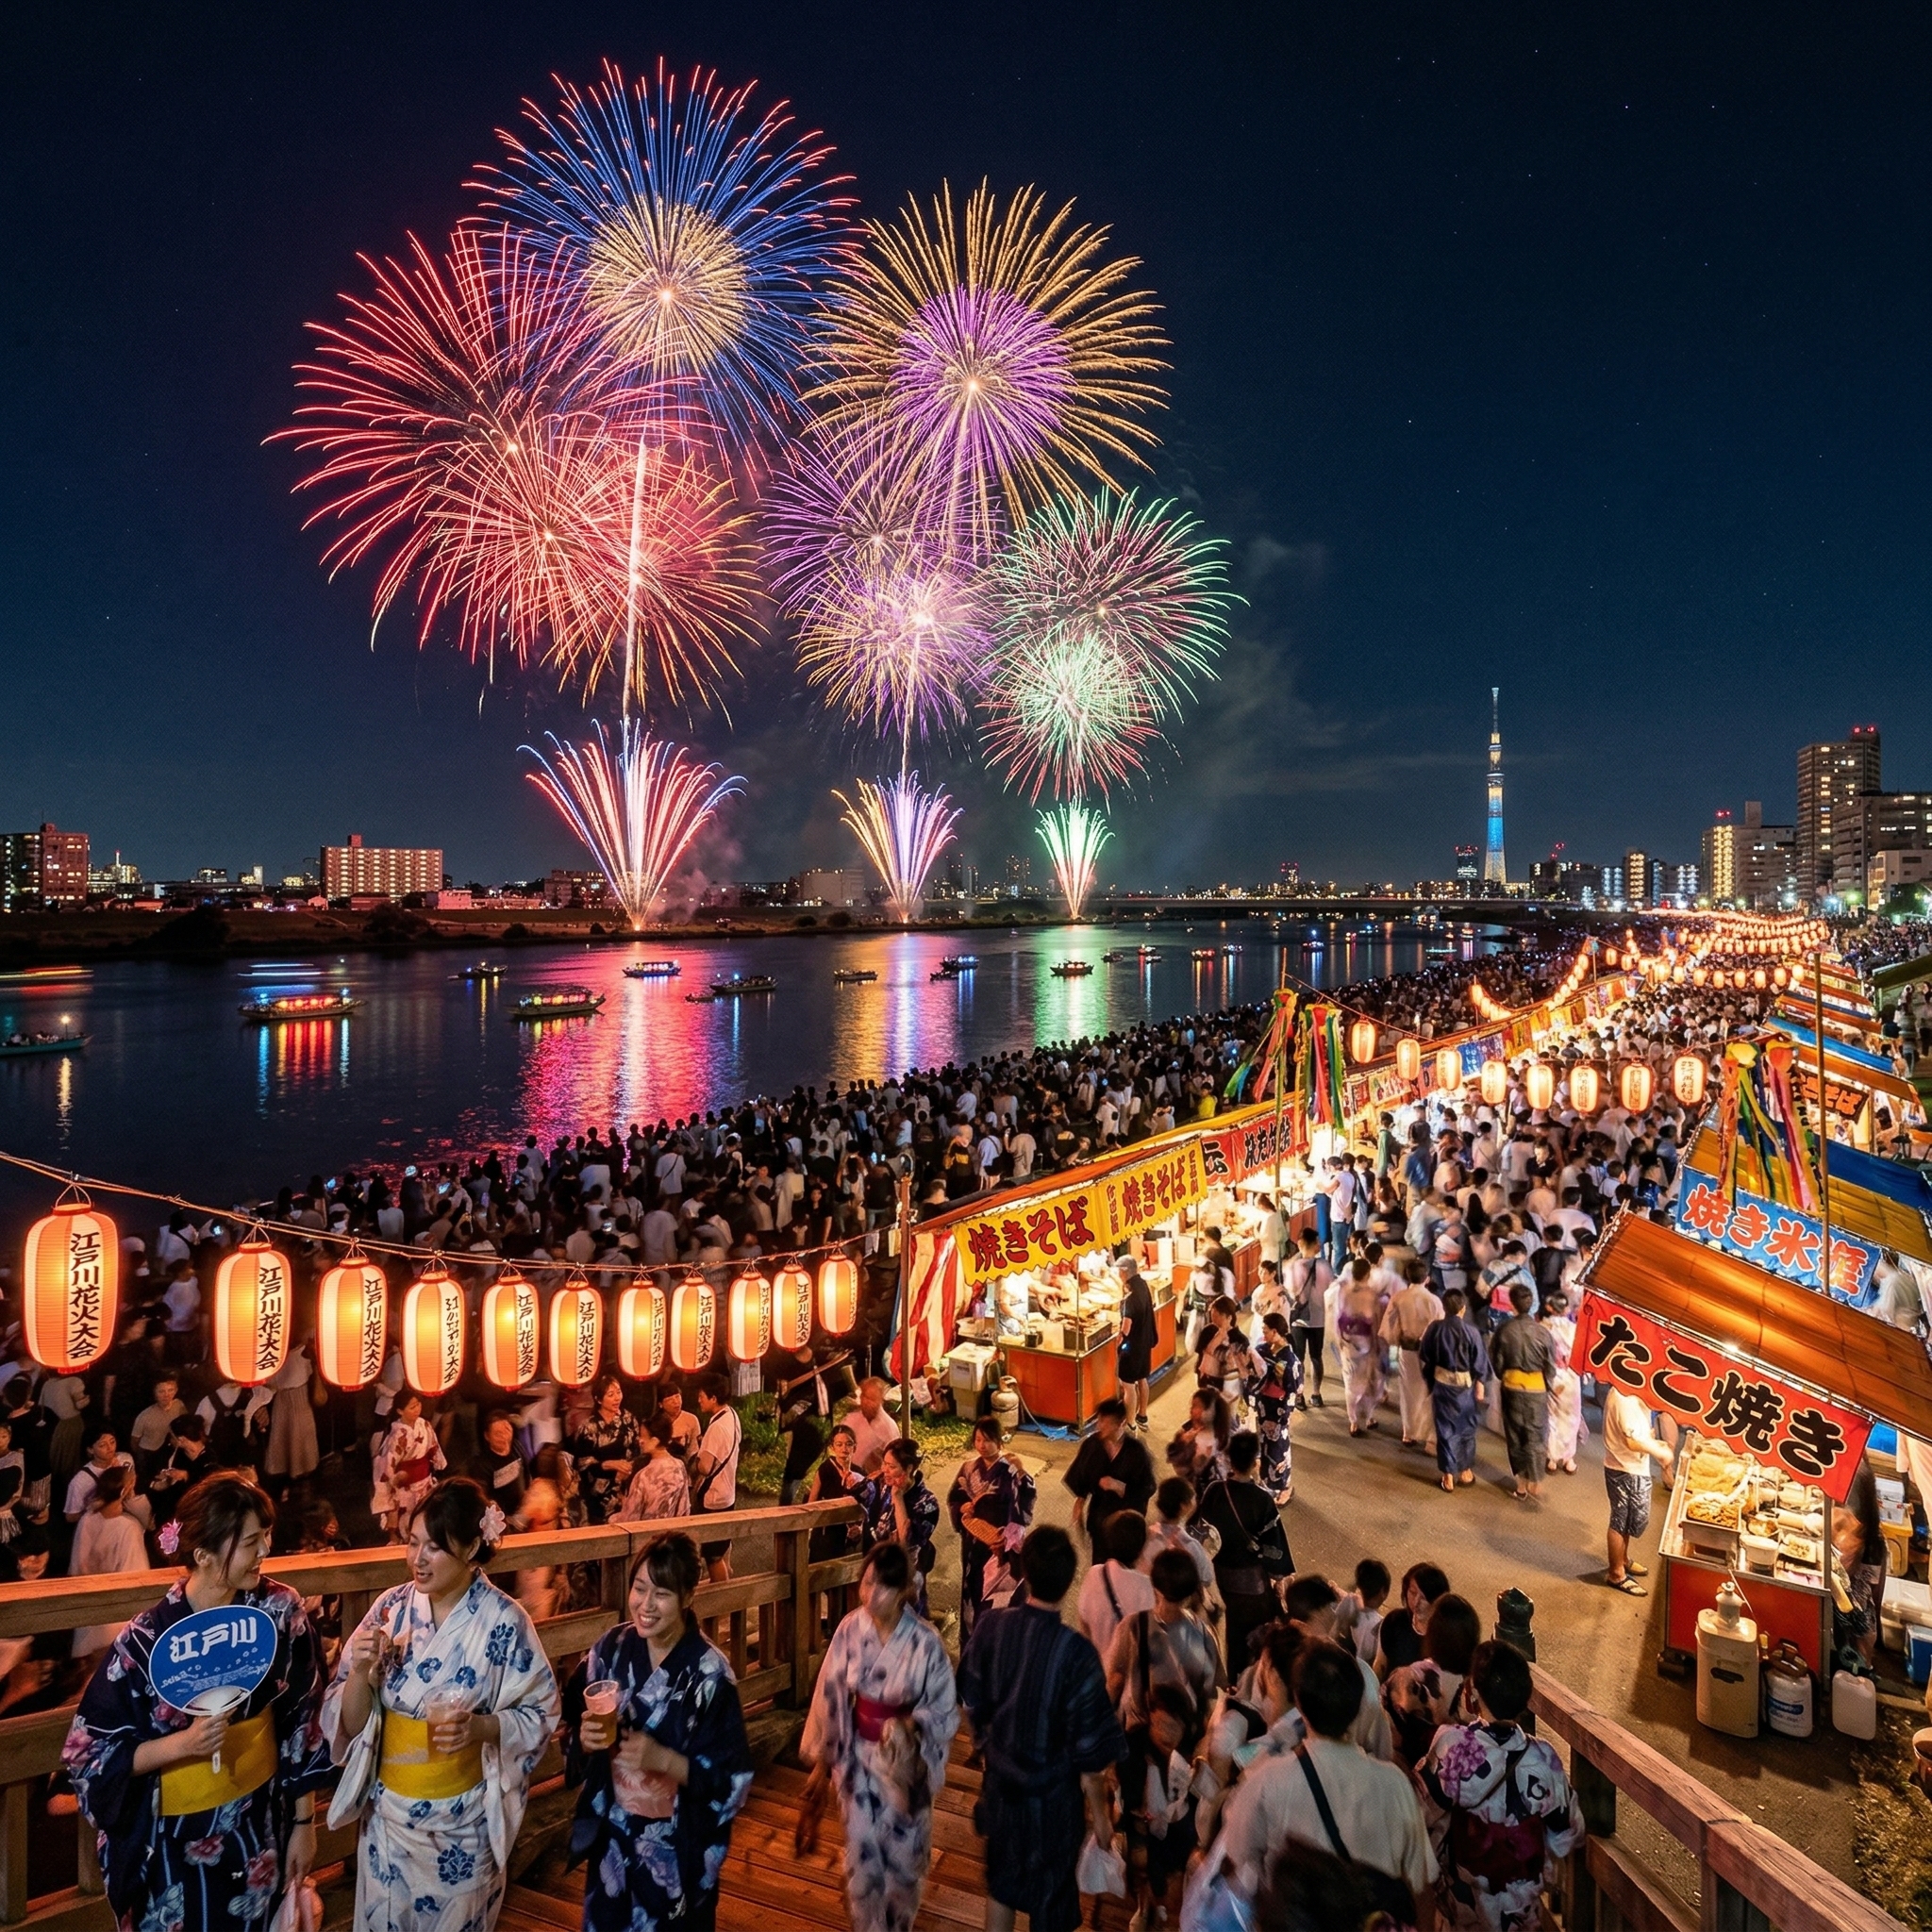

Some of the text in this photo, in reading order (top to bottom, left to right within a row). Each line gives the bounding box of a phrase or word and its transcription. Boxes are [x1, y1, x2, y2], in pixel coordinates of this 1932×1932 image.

[967, 1195, 1095, 1273] 焼きそば
[1122, 1154, 1187, 1227] 焼きそば
[66, 1231, 101, 1359] 江戸川花火大会
[360, 1277, 383, 1377] 江戸川花火大会
[1589, 1313, 1848, 1477] たこ焼き
[169, 1616, 258, 1664] 江戸川
